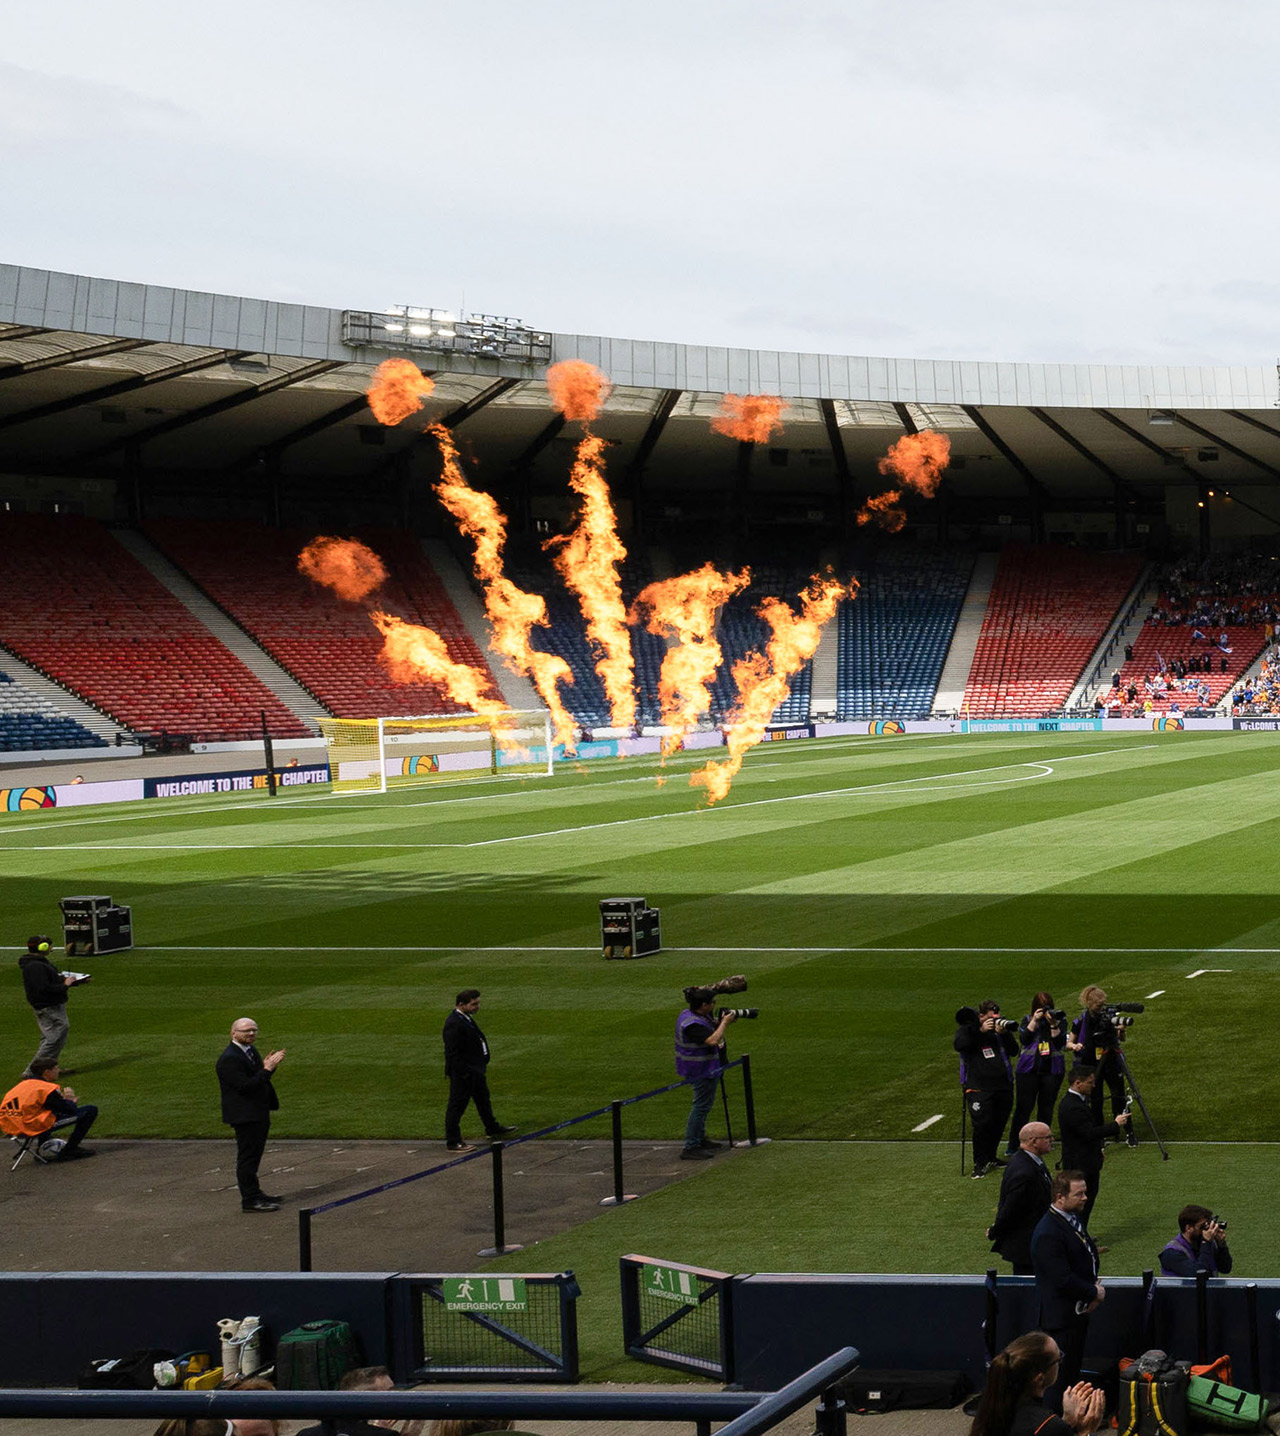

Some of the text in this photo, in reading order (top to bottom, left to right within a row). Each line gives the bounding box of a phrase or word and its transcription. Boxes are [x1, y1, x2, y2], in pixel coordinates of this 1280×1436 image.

[970, 722, 1095, 732] WELCOME TO THE NEXT CHAPTER
[1240, 721, 1276, 731] WELCOME
[156, 769, 328, 797] WELCOME TO THE NET CHAPTER
[647, 1286, 699, 1305] EMERGENCY EXIT
[447, 1302, 526, 1310] EMERGENCY EXIT
[1206, 1382, 1247, 1415] H
